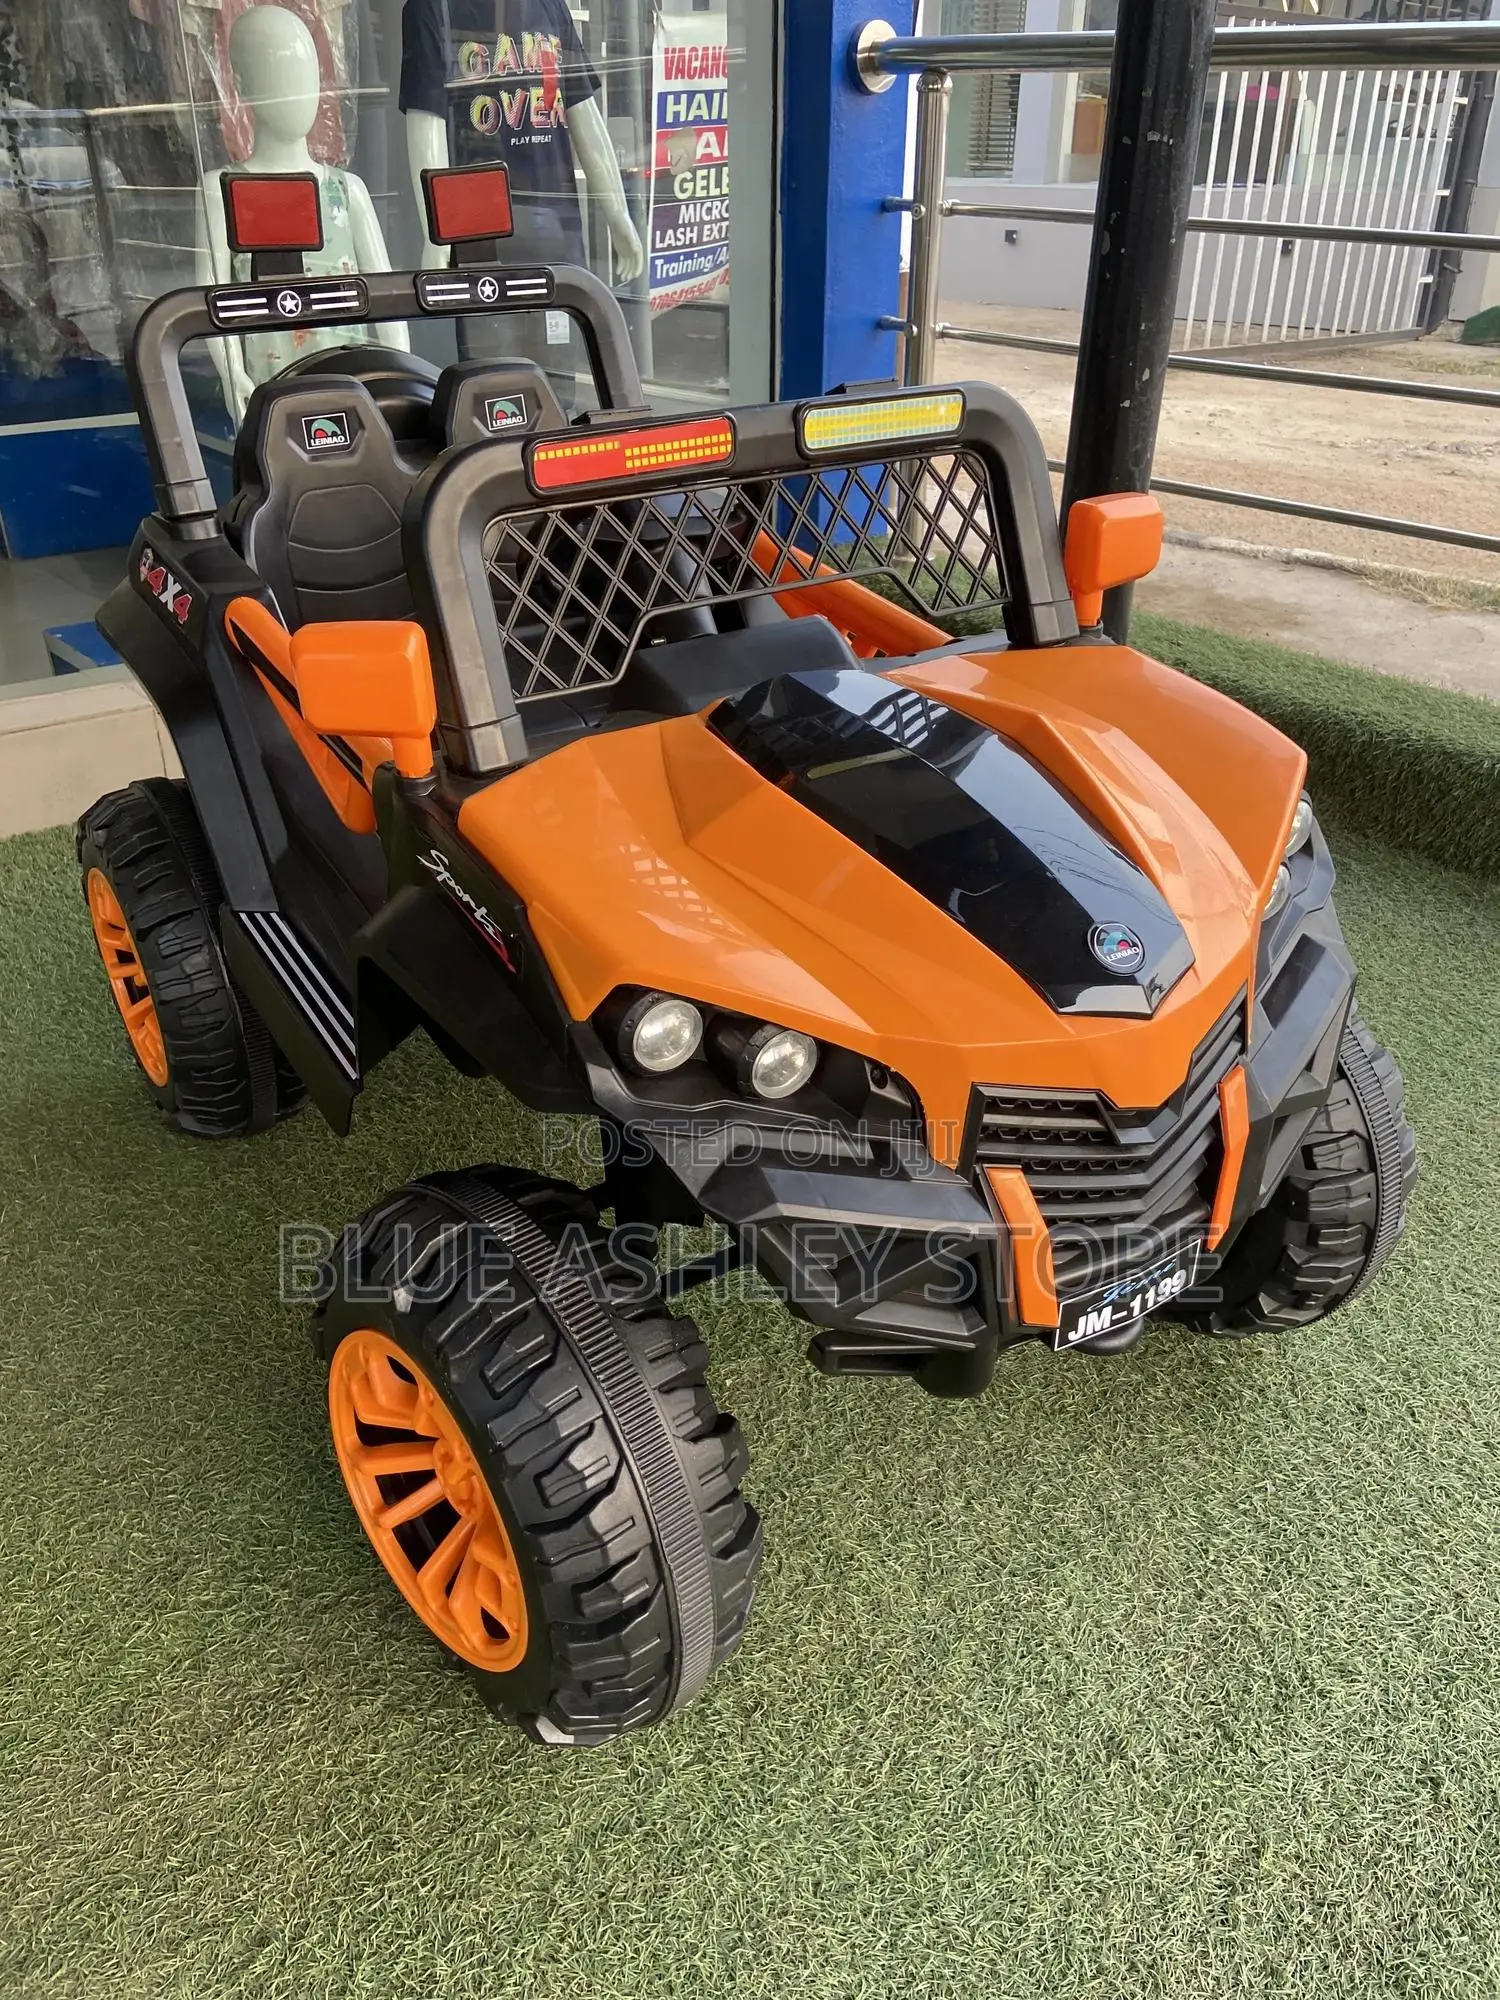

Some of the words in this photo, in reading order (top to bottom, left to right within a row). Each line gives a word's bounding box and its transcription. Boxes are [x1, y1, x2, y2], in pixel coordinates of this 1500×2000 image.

[511, 136, 530, 146] PLAY
[531, 134, 553, 144] REPEAT
[655, 226, 698, 248] LASH
[492, 415, 523, 428] LEINIAO
[310, 435, 345, 447] LEINIAO
[147, 566, 193, 625] 4X4
[1106, 946, 1140, 962] LEINIAO
[1067, 1269, 1188, 1342] JM-1199
